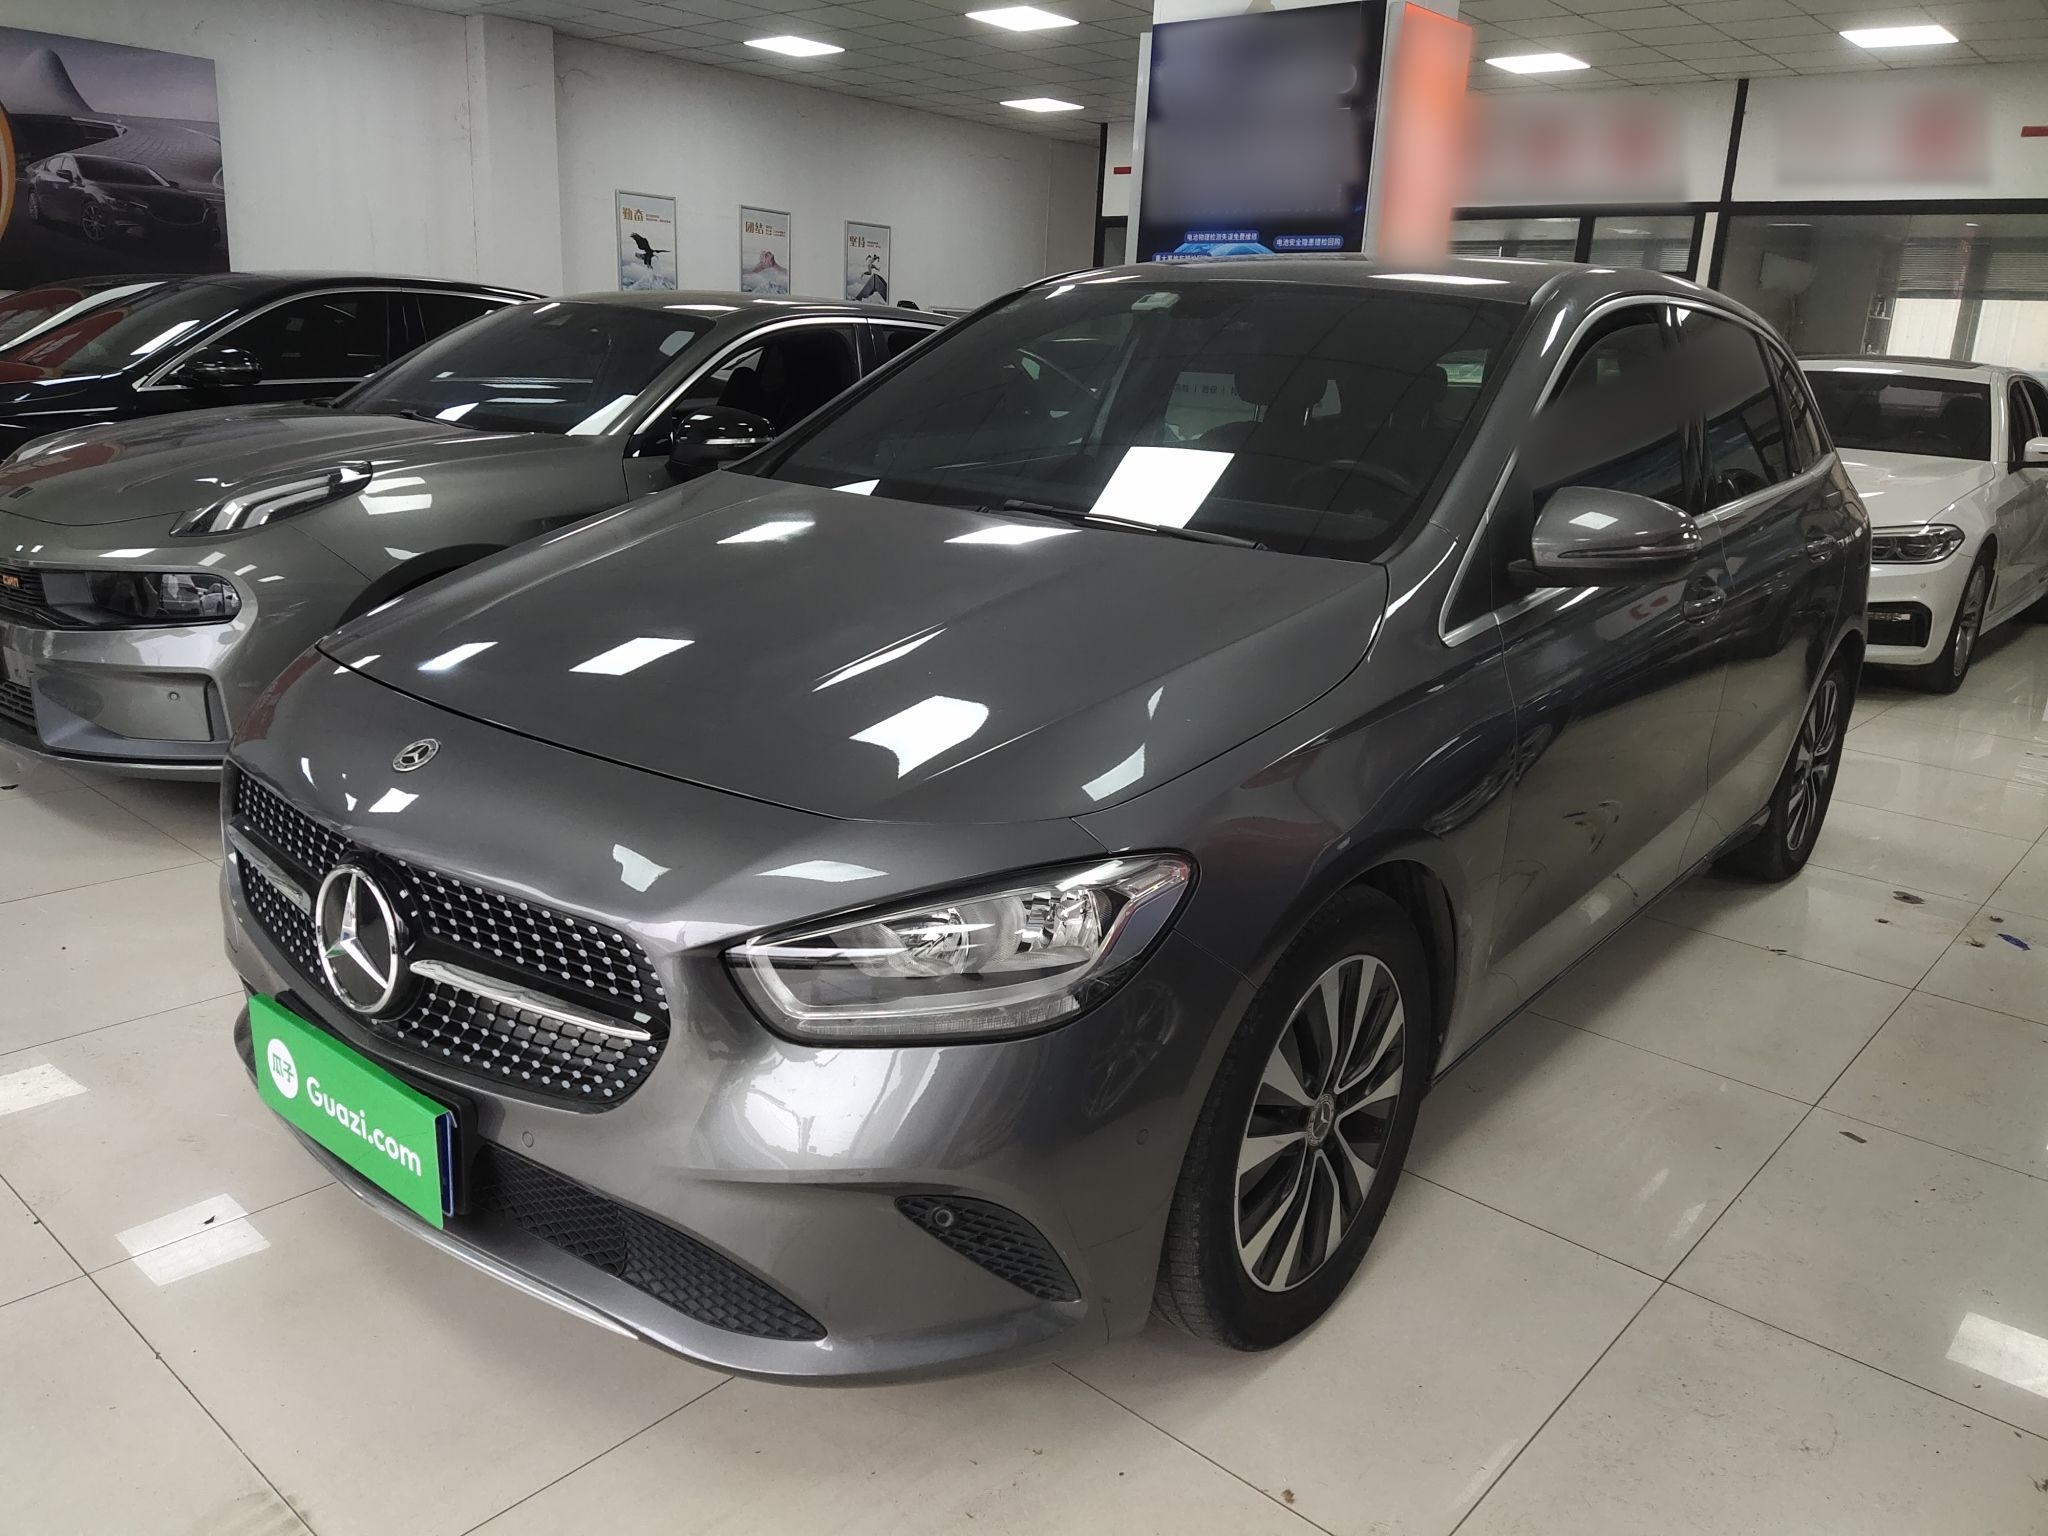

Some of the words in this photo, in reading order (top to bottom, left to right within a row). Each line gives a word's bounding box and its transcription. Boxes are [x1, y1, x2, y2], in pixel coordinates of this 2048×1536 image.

[622, 207, 644, 222] 勤奋
[745, 221, 764, 235] 团结
[848, 236, 865, 248] 坚持
[272, 1051, 295, 1084] 瓜子
[306, 1075, 422, 1177] Guazi.com
